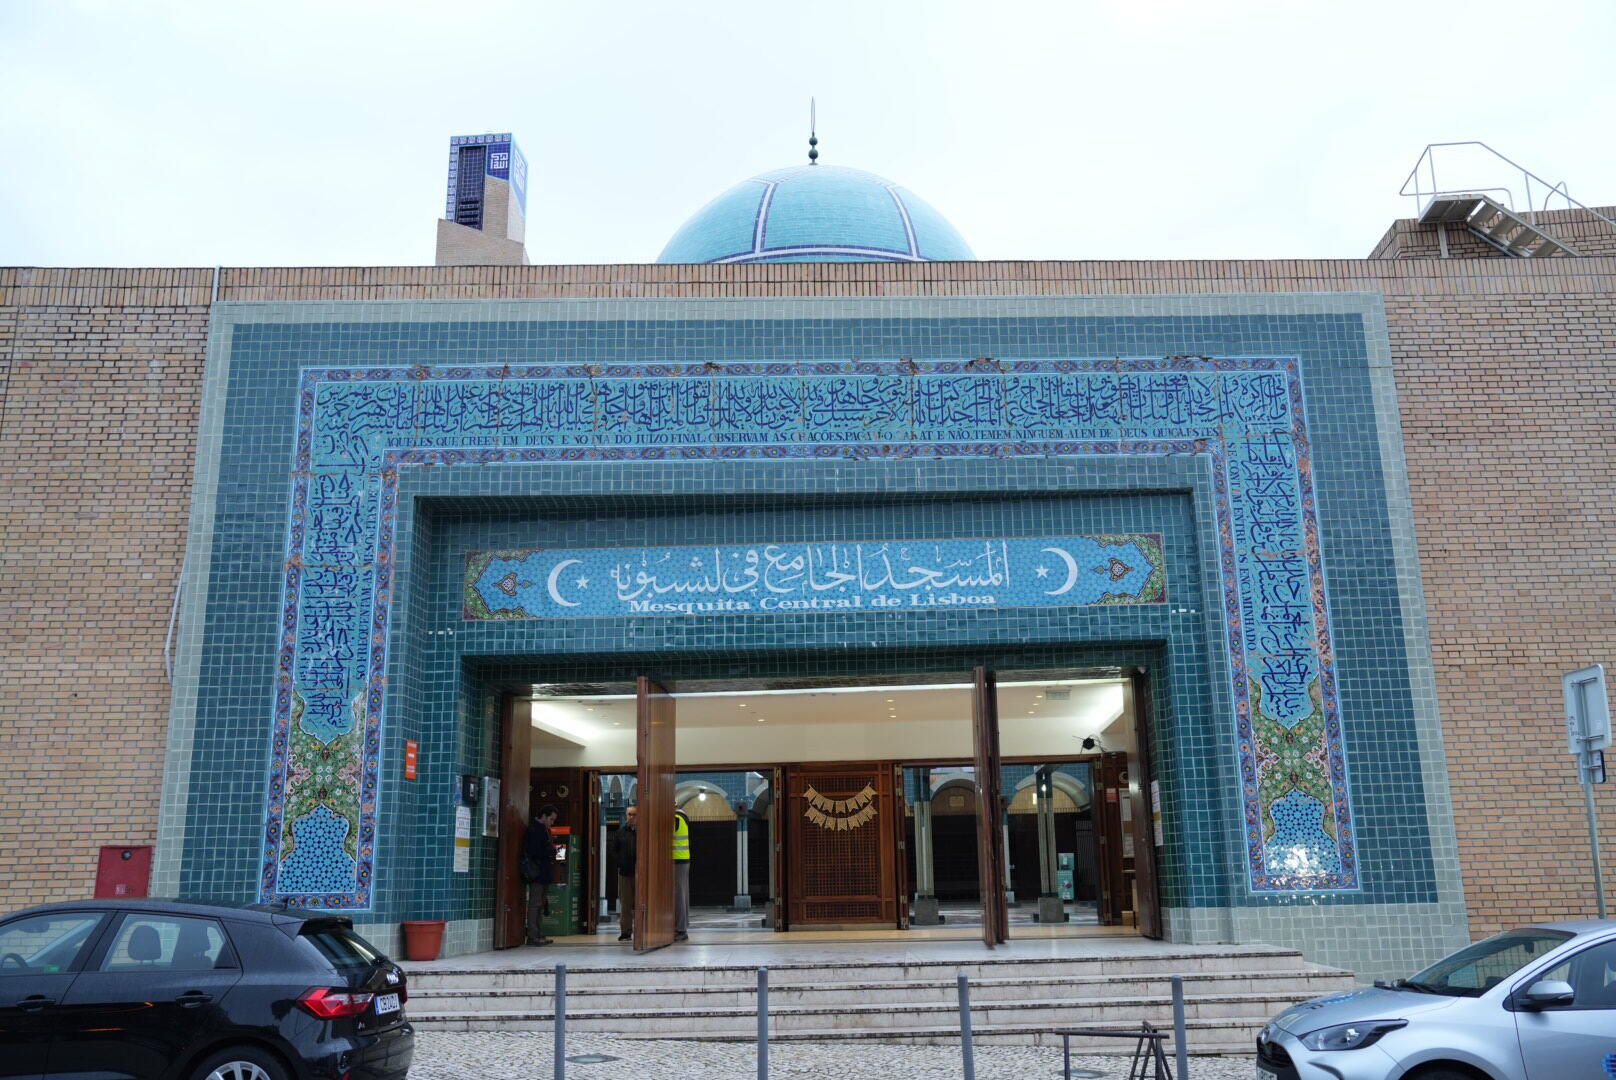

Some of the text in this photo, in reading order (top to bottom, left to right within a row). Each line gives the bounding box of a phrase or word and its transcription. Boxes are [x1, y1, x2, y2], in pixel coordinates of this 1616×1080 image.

[436, 436, 457, 446] QUE
[503, 436, 518, 446] EM
[525, 435, 554, 445] DEUS
[562, 435, 569, 445] E
[574, 434, 589, 445] NO
[615, 434, 632, 444] DO
[635, 433, 668, 444] JUIZO
[708, 432, 768, 443] OBSERVAM
[937, 430, 944, 441] E
[1015, 429, 1063, 440] NINGUEM
[1099, 428, 1112, 439] DE
[1120, 428, 1148, 439] DEUS
[370, 455, 381, 482] DEUS
[1227, 442, 1238, 456] SE
[1233, 507, 1246, 545] ENTRE
[628, 593, 996, 614] Mesquita Central de Lisboa
